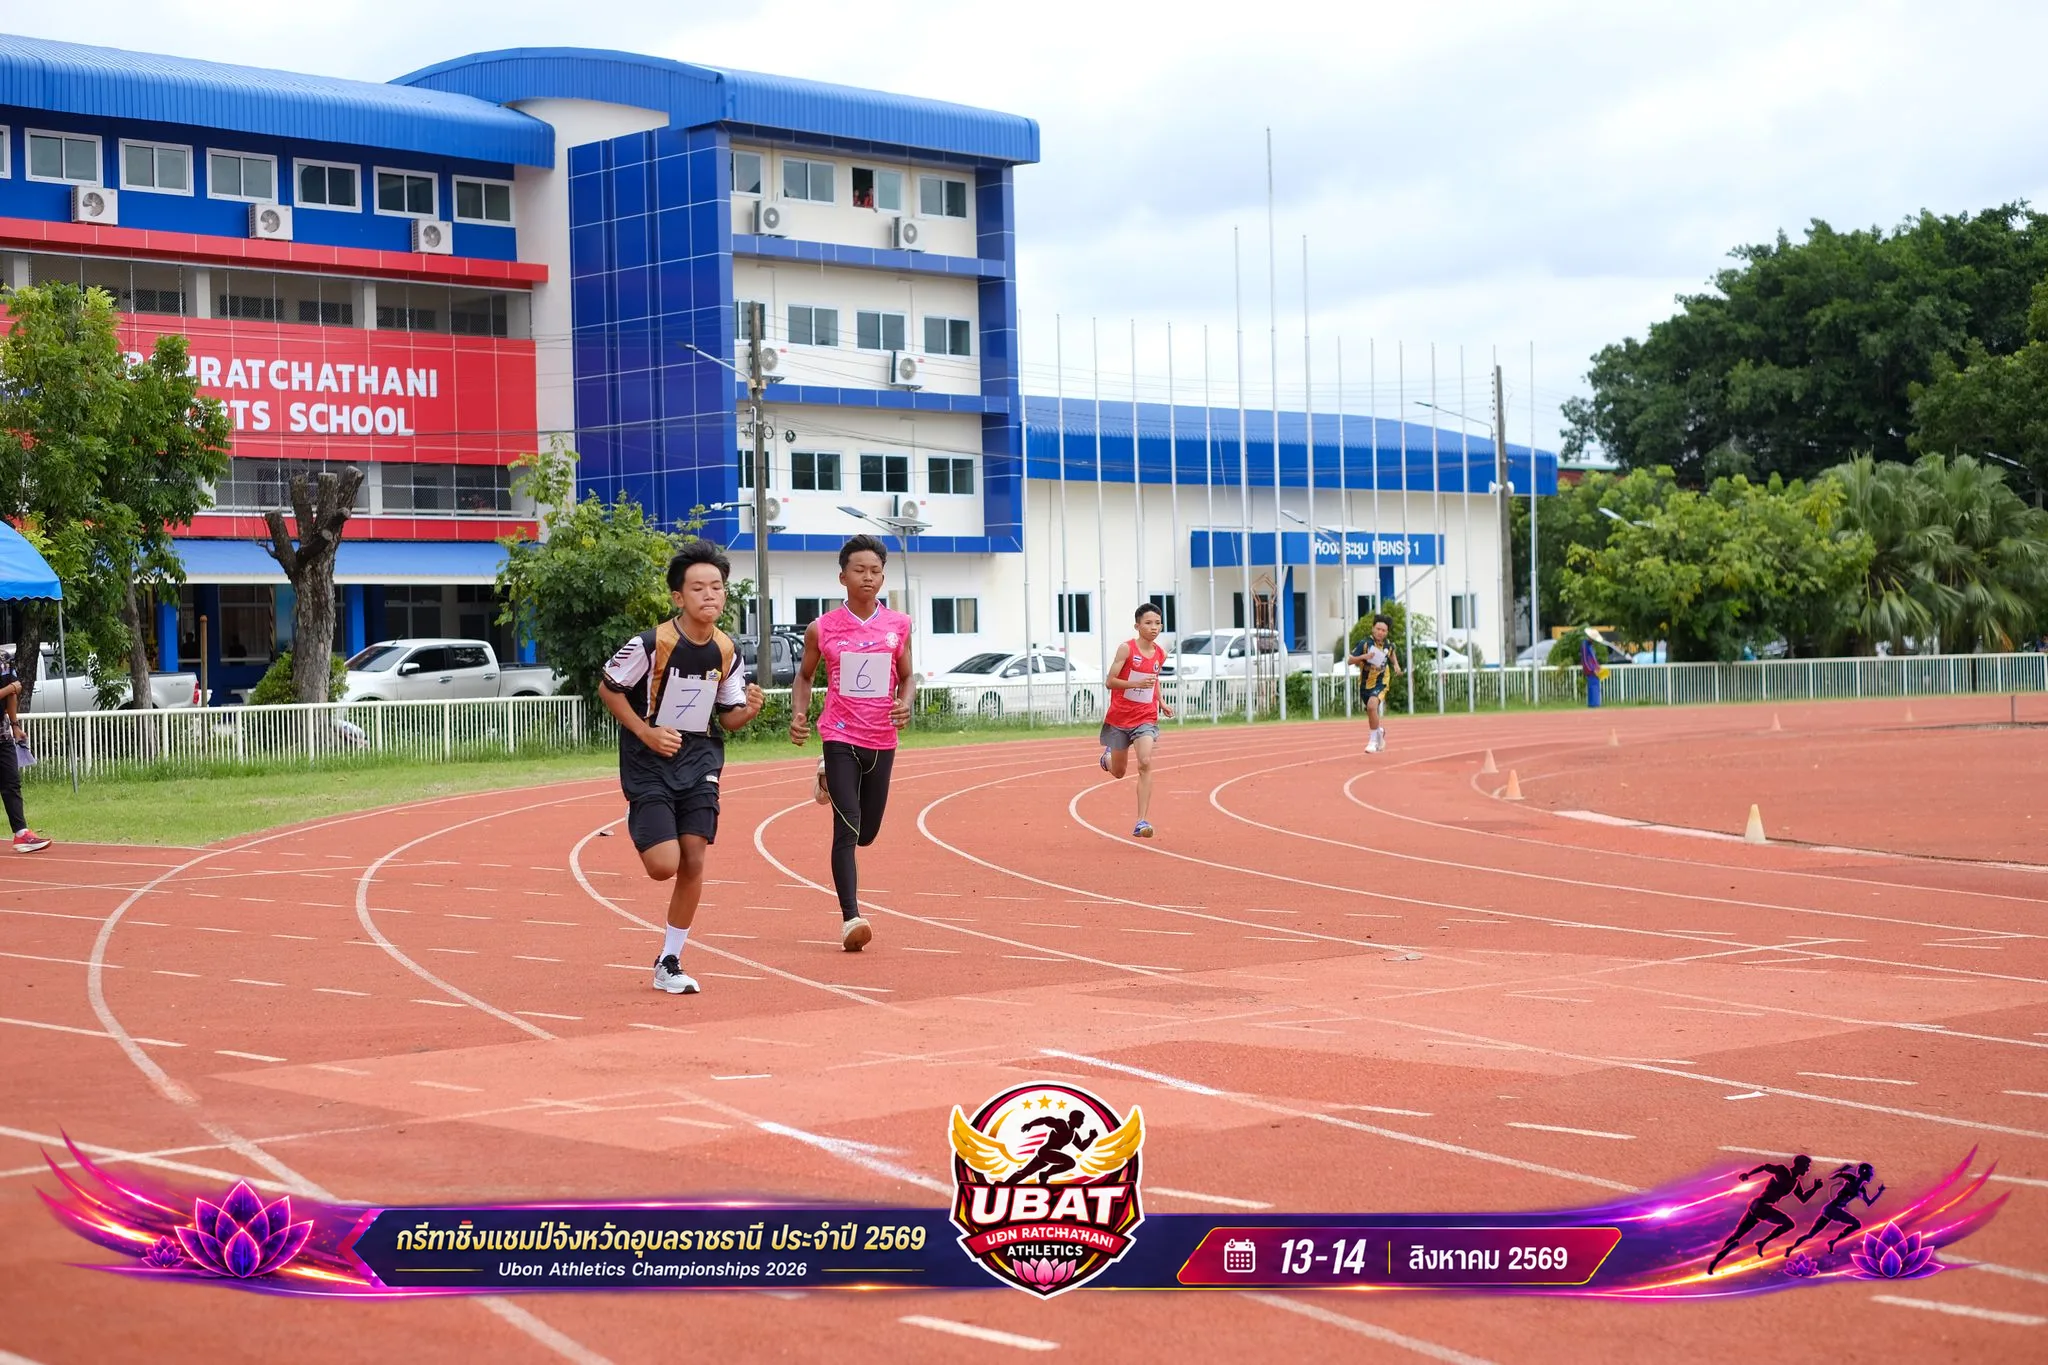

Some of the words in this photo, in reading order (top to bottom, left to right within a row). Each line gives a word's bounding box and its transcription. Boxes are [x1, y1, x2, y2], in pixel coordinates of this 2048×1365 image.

[289, 402, 415, 437] SCHOOL
[1414, 541, 1420, 556] 1
[856, 659, 871, 689] 6
[675, 688, 702, 719] 7
